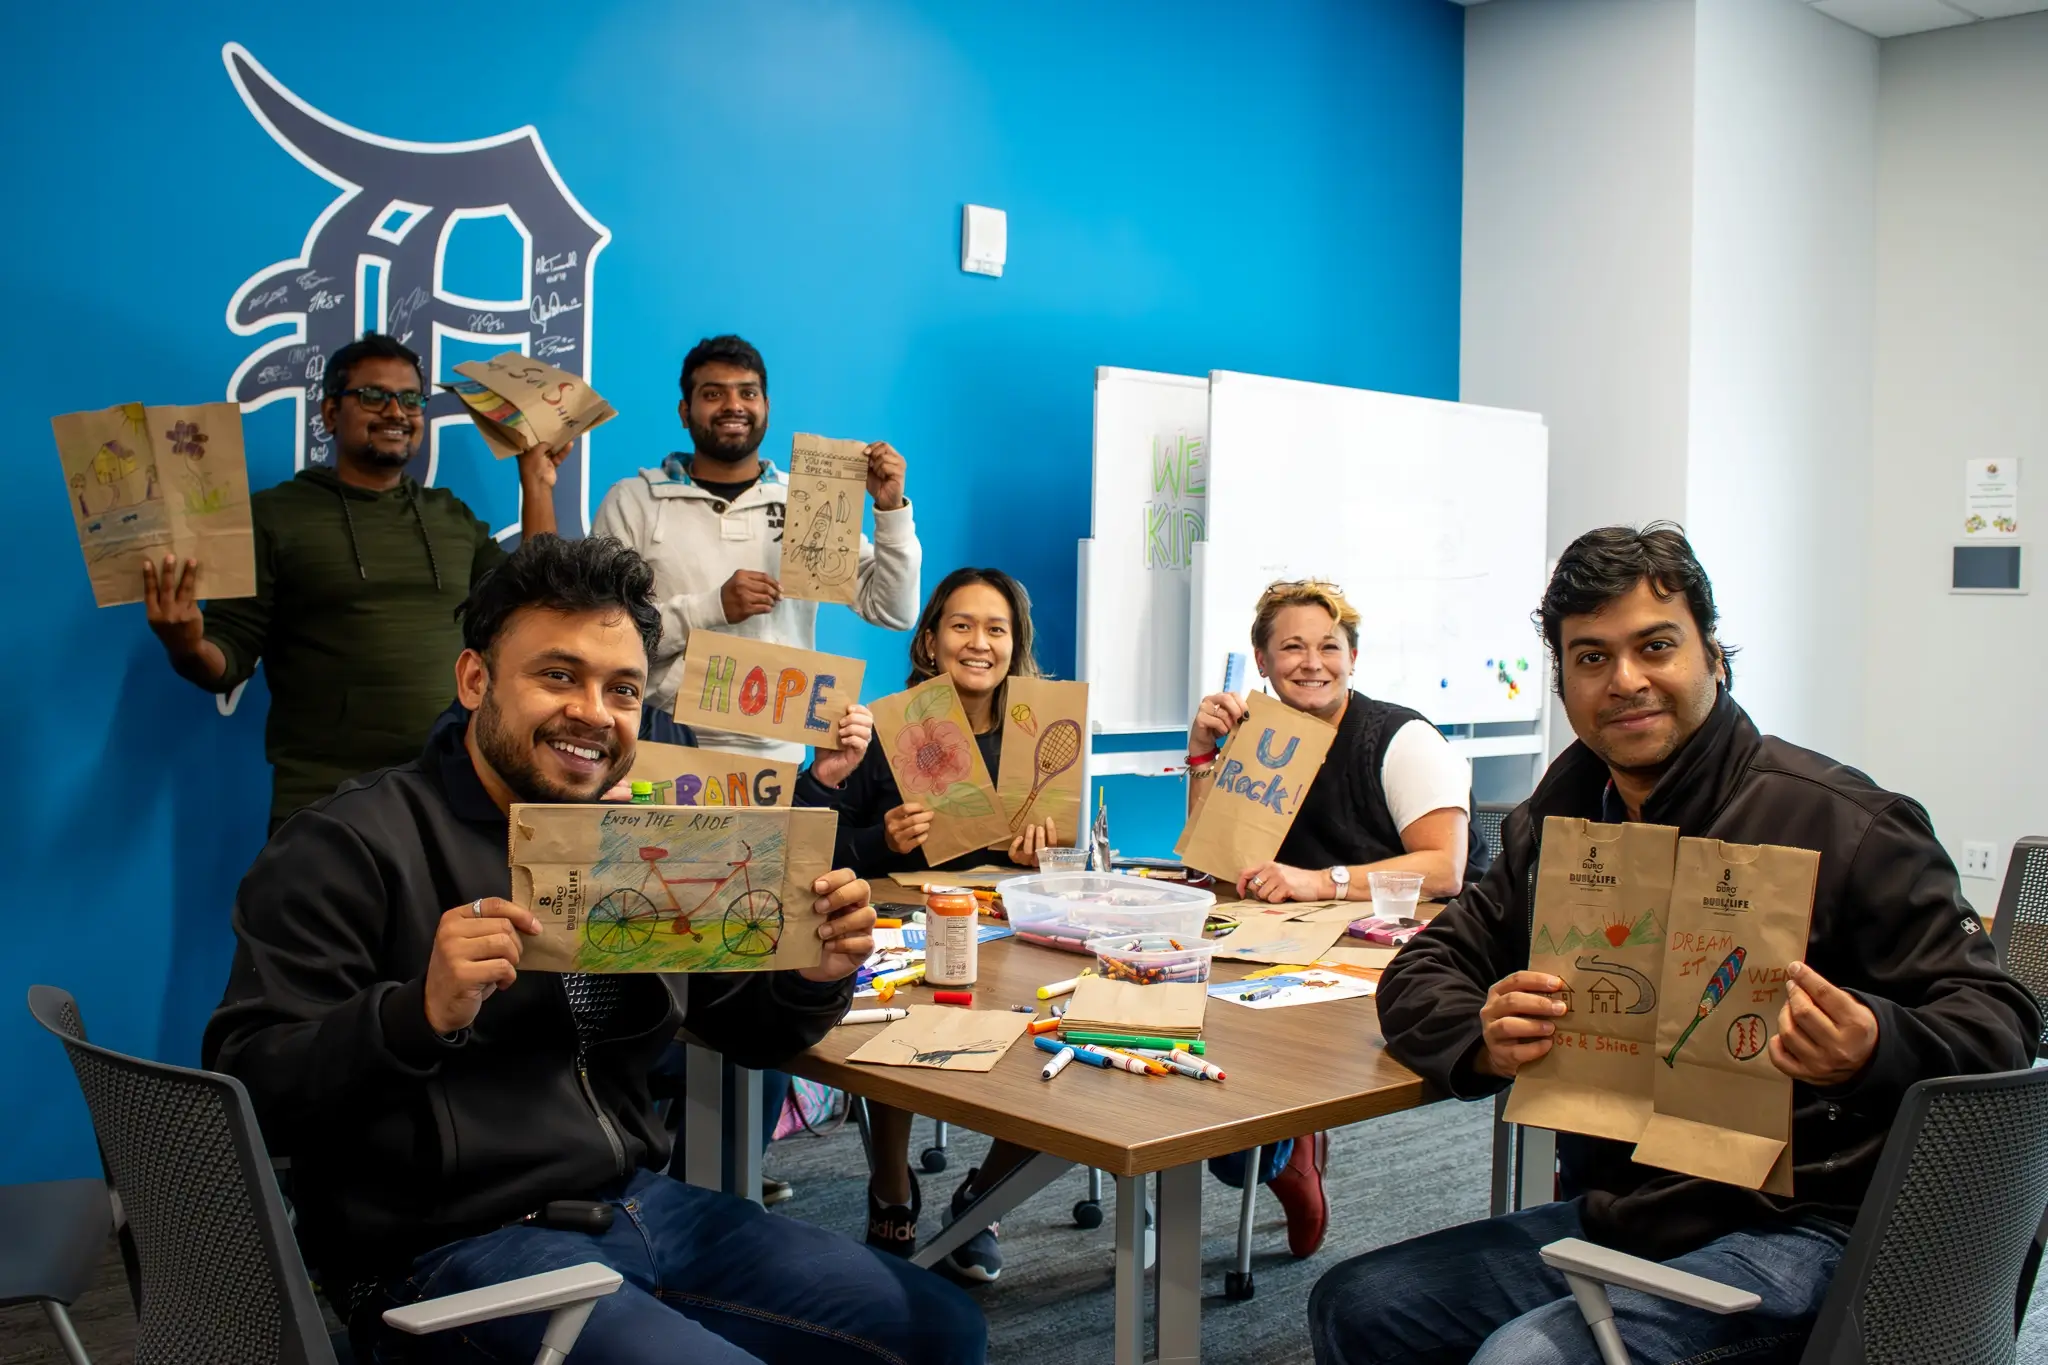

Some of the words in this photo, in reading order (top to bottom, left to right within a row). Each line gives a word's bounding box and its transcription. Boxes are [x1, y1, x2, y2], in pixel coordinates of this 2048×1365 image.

[804, 455, 820, 465] YOU
[1152, 433, 1206, 499] WE
[699, 655, 836, 733] HOPE
[1256, 727, 1300, 769] U
[651, 768, 782, 806] TRONG
[645, 811, 675, 828] THE
[688, 813, 733, 831] RIDE
[1589, 846, 1597, 858] 8
[1582, 862, 1604, 870] DURO
[1723, 868, 1731, 881] 8
[569, 870, 578, 894] LIFE
[1596, 875, 1617, 884] LIFE
[1716, 885, 1737, 893] DURO
[539, 896, 552, 906] 8
[555, 886, 564, 915] DURO
[1730, 899, 1749, 909] LIFE
[1672, 931, 1733, 952] DREAM
[1679, 955, 1706, 977] IT
[1751, 987, 1779, 1003] IT
[1595, 1035, 1640, 1056] Shine
